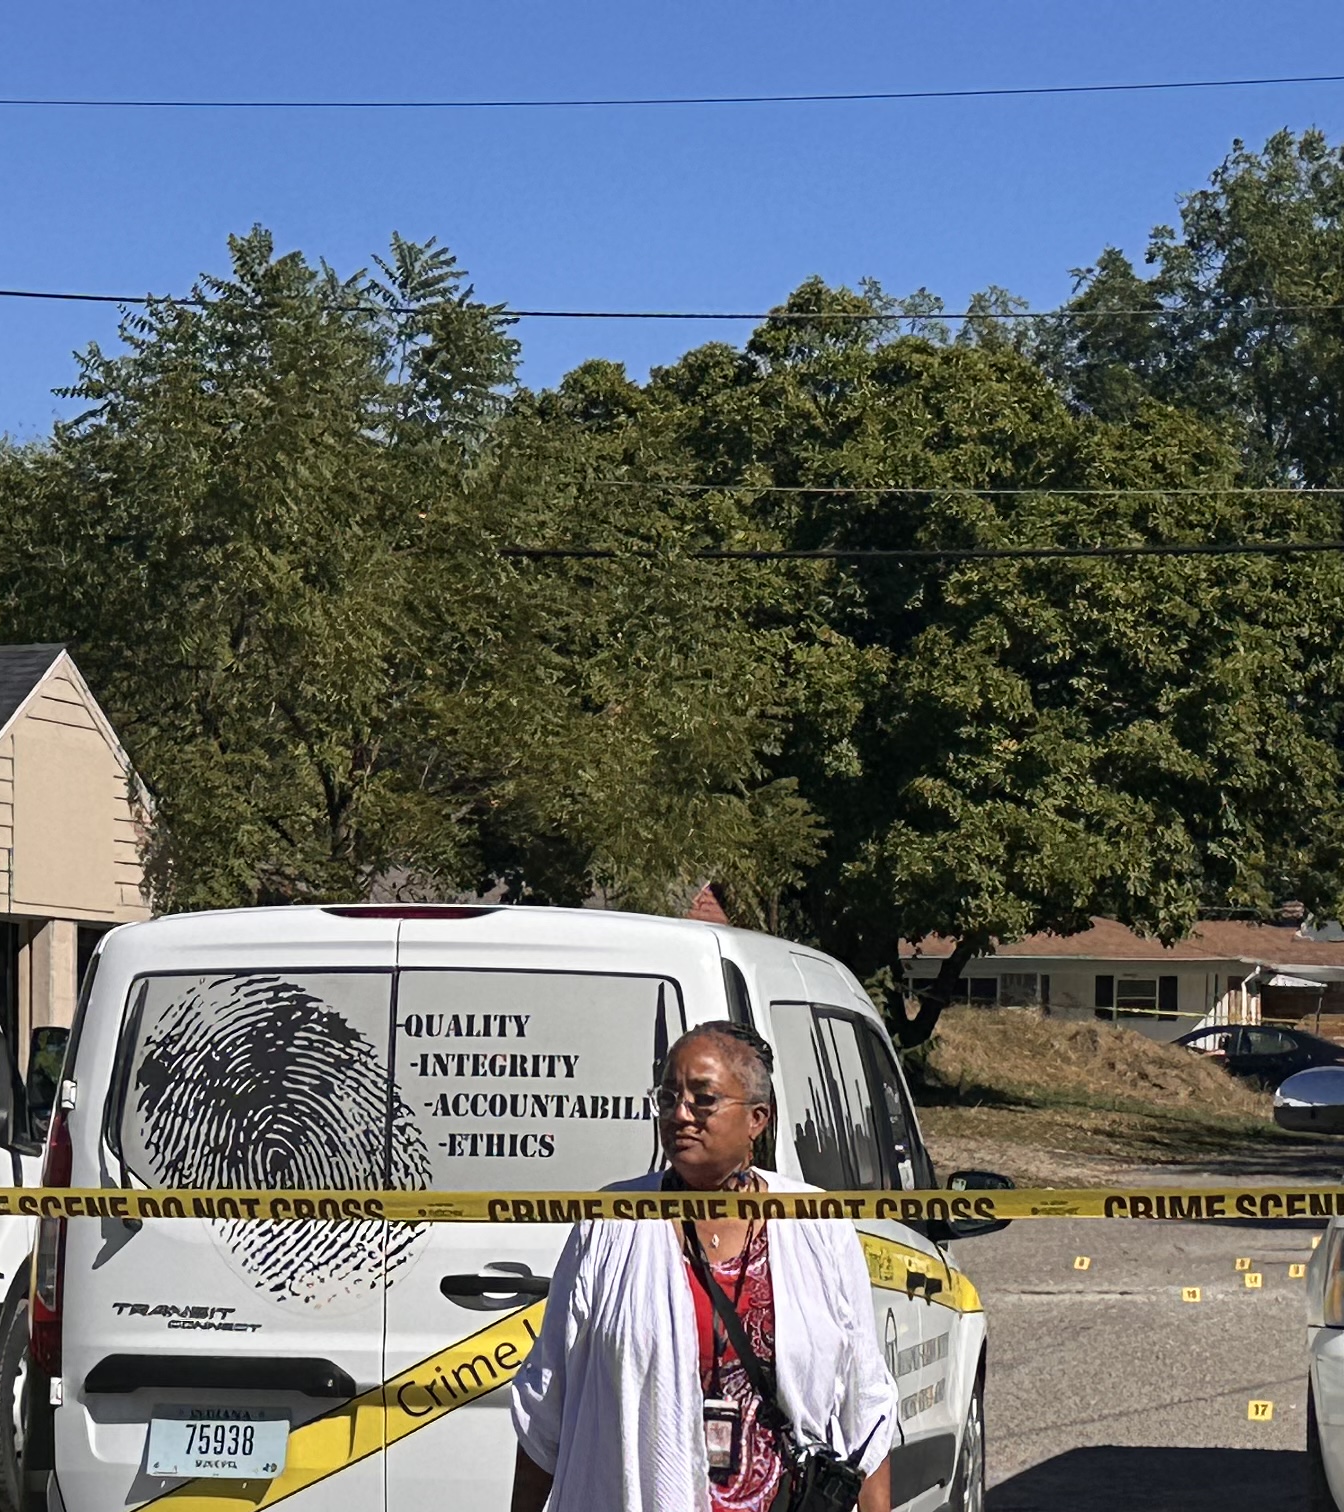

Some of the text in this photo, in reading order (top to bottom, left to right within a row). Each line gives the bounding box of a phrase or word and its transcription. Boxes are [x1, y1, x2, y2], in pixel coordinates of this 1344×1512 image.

[112, 1302, 236, 1320] TRANSIT
[168, 1319, 262, 1332] CONNECT
[397, 1341, 523, 1418] Crime
[185, 1423, 255, 1456] 75938
